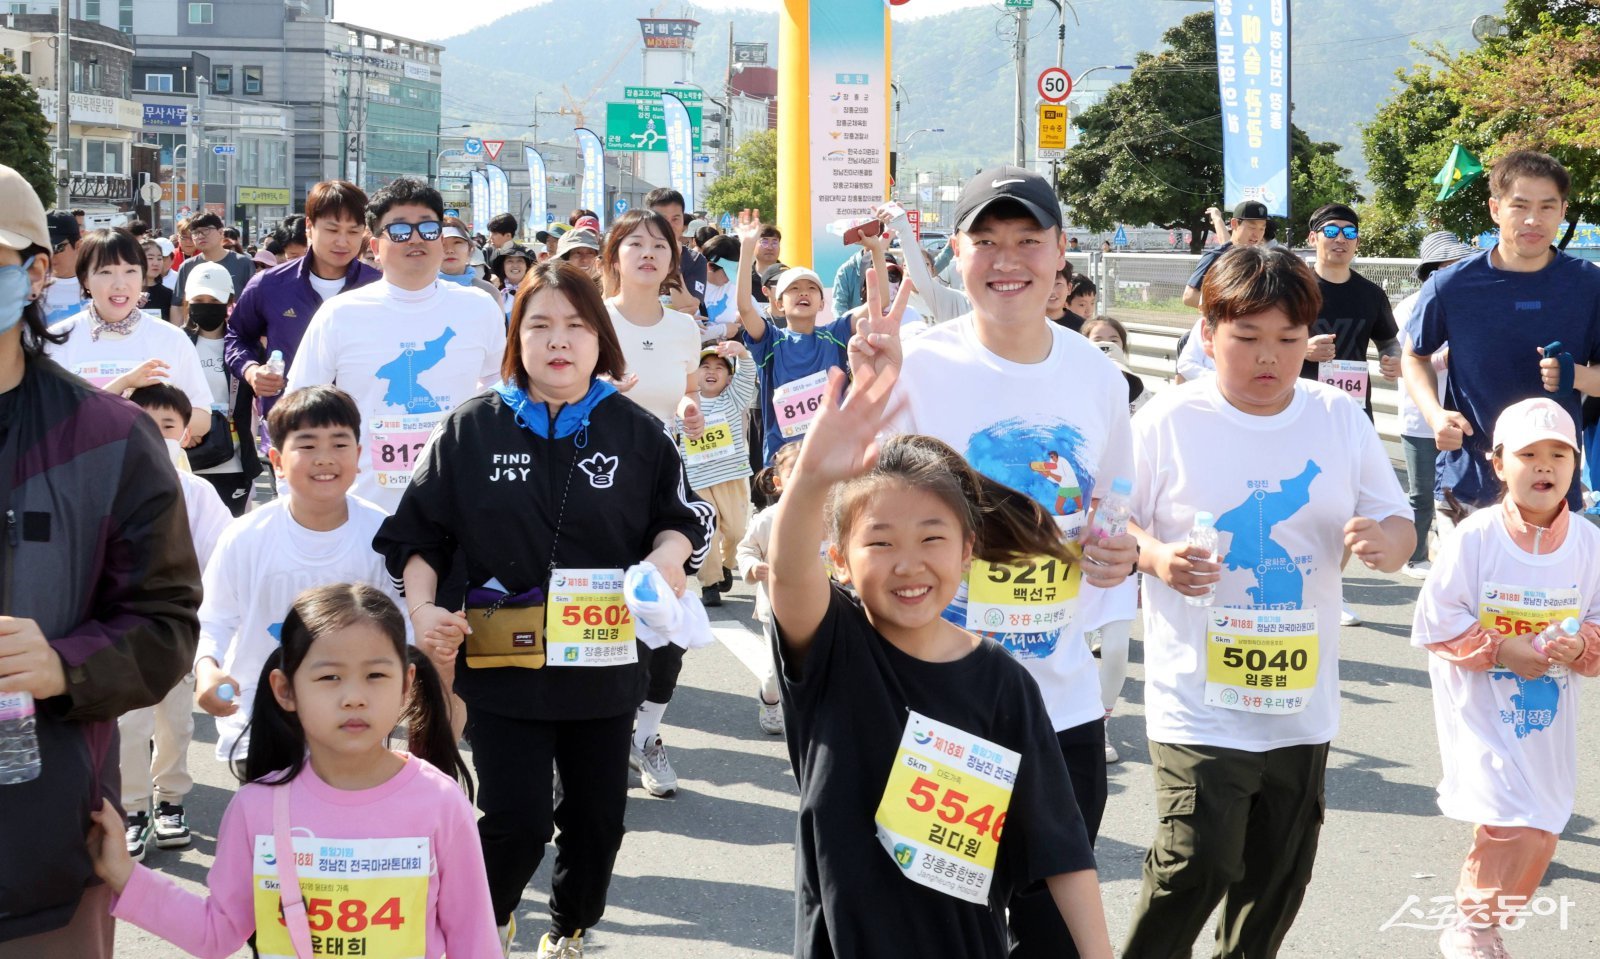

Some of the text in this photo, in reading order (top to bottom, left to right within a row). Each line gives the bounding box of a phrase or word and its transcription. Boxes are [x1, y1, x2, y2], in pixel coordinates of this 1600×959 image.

[644, 23, 683, 35] 리버스
[647, 37, 681, 48] MOTEL
[1045, 78, 1065, 92] 50
[1326, 378, 1362, 392] 8164
[690, 430, 725, 447] 5163
[493, 454, 531, 464] FIND
[390, 475, 411, 484] 농협
[987, 560, 1072, 584] 5217
[568, 578, 588, 587] 제18회
[592, 581, 611, 589] 정남진
[1013, 587, 1056, 601] 백선규
[1523, 597, 1542, 606] 정남진
[562, 604, 631, 626] 5602
[1009, 608, 1066, 626] 장흥우리병원
[1231, 618, 1254, 629] 제18회
[1257, 623, 1277, 633] 정남진
[1494, 615, 1550, 636] 563
[583, 628, 619, 640] 최민경
[584, 644, 628, 657] 장흥종합병원
[1223, 647, 1308, 671] 5040
[1245, 673, 1287, 687] 임종범
[1242, 695, 1303, 708] 장흥우리병원
[1527, 709, 1552, 726] 장흥
[933, 737, 965, 759] 제18회
[907, 756, 928, 772] 5km
[967, 755, 994, 776] 정남진
[928, 823, 982, 858] 김다원
[293, 852, 314, 866] 18회
[318, 857, 421, 872] 정남진 전국마라톤대회
[922, 853, 987, 888] 장흥종합병원
[312, 935, 367, 957] 윤태희
